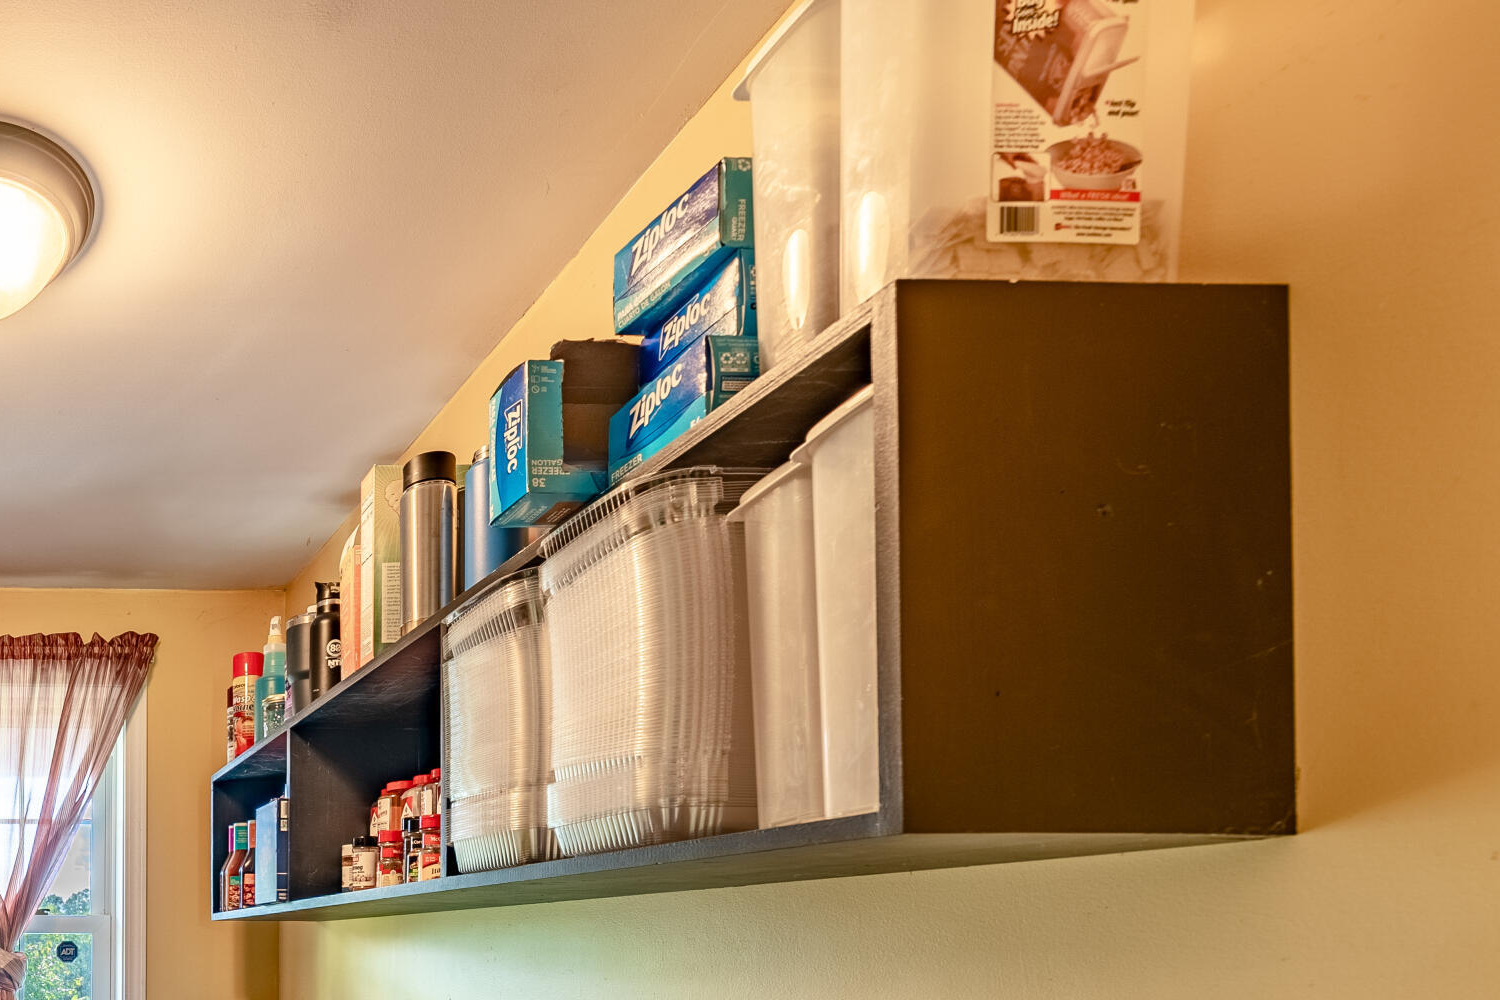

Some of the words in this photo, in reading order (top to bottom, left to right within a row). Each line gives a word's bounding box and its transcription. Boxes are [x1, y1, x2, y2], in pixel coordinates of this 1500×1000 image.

[631, 194, 690, 277] Ziploc
[738, 198, 746, 243] FREEZER
[662, 293, 710, 352] Ziploc
[628, 363, 683, 441] Ziploc
[503, 403, 521, 474] Ziploc
[532, 466, 570, 475] REEZER
[532, 477, 546, 487] 38
[611, 453, 643, 483] FREEZER
[60, 947, 75, 956] ADT
